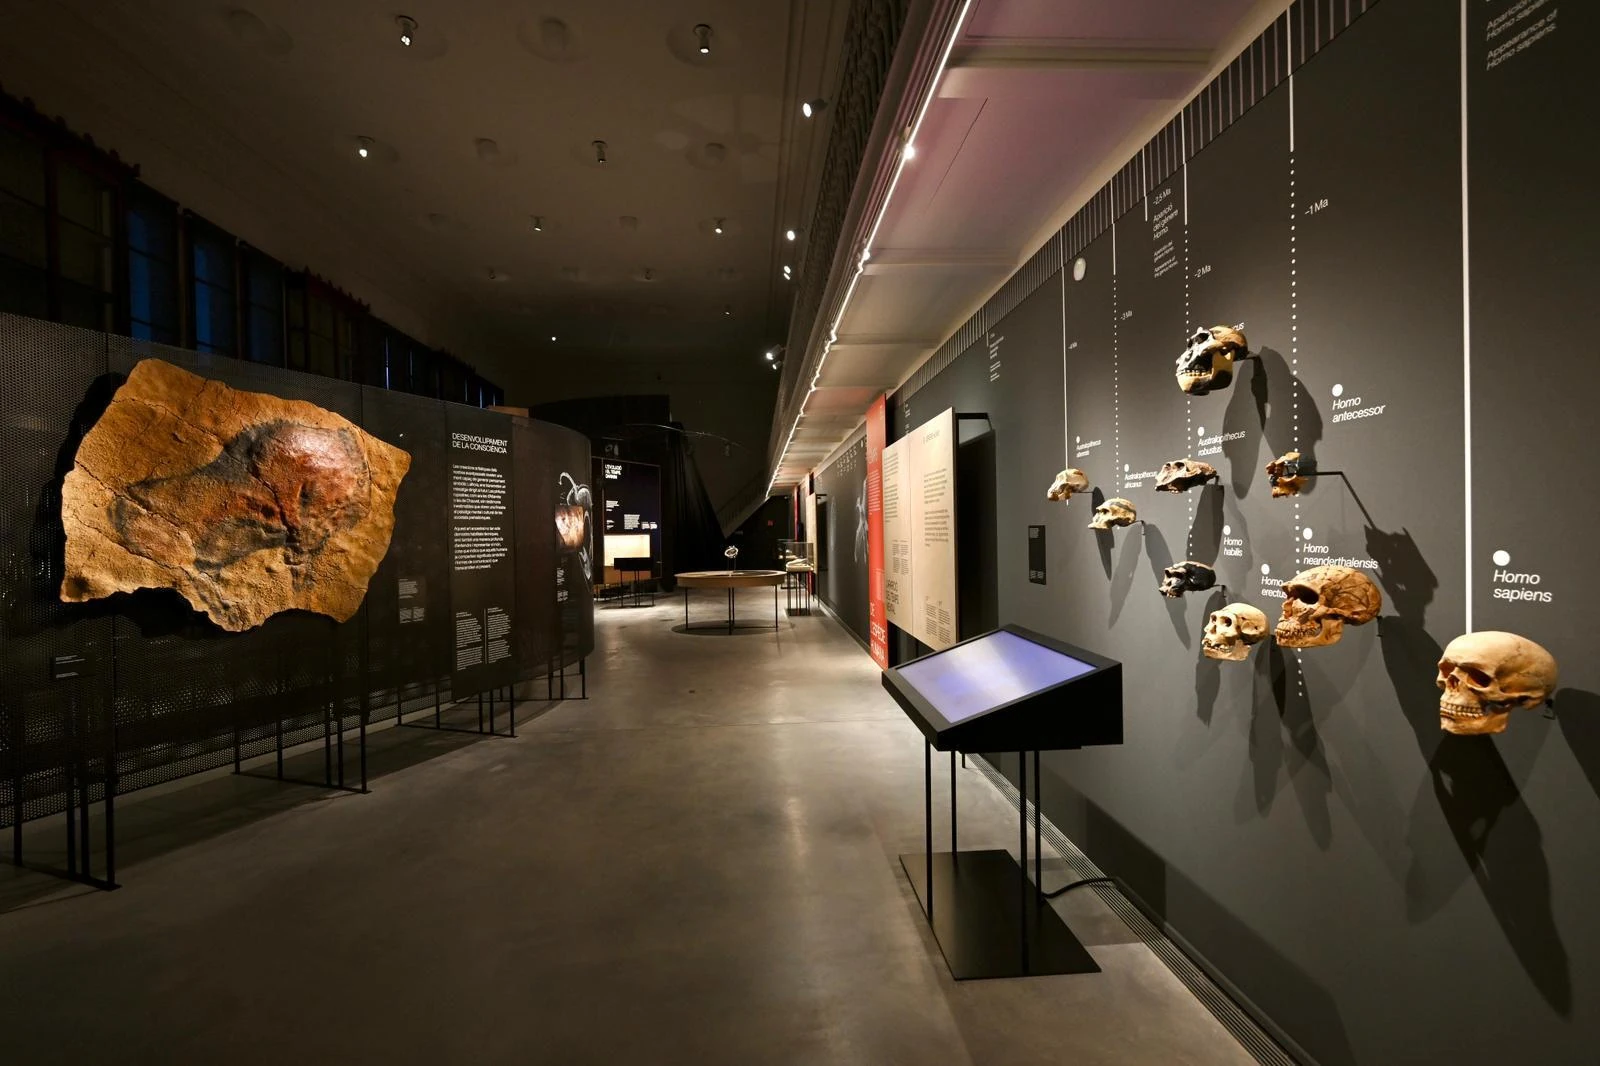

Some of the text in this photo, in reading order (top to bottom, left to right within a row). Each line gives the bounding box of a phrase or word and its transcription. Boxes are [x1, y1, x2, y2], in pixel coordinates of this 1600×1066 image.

[1486, 8, 1557, 60] Appearance of
[1515, 22, 1557, 52] sapiens
[1314, 198, 1328, 213] Ma
[1332, 396, 1361, 410] Homo
[1332, 405, 1386, 423] antecessor
[452, 440, 461, 449] DE
[461, 442, 470, 450] LA
[1198, 430, 1246, 447] Australopithecus
[1198, 445, 1223, 457] robustus
[1223, 537, 1243, 546] Homo
[1303, 543, 1329, 554] Homo
[1223, 547, 1243, 557] habilis
[1303, 555, 1378, 570] neanderthalensis
[1261, 576, 1283, 587] Homo
[1493, 569, 1541, 585] Homo
[1261, 588, 1288, 599] erectus
[1493, 587, 1553, 603] sapiens
